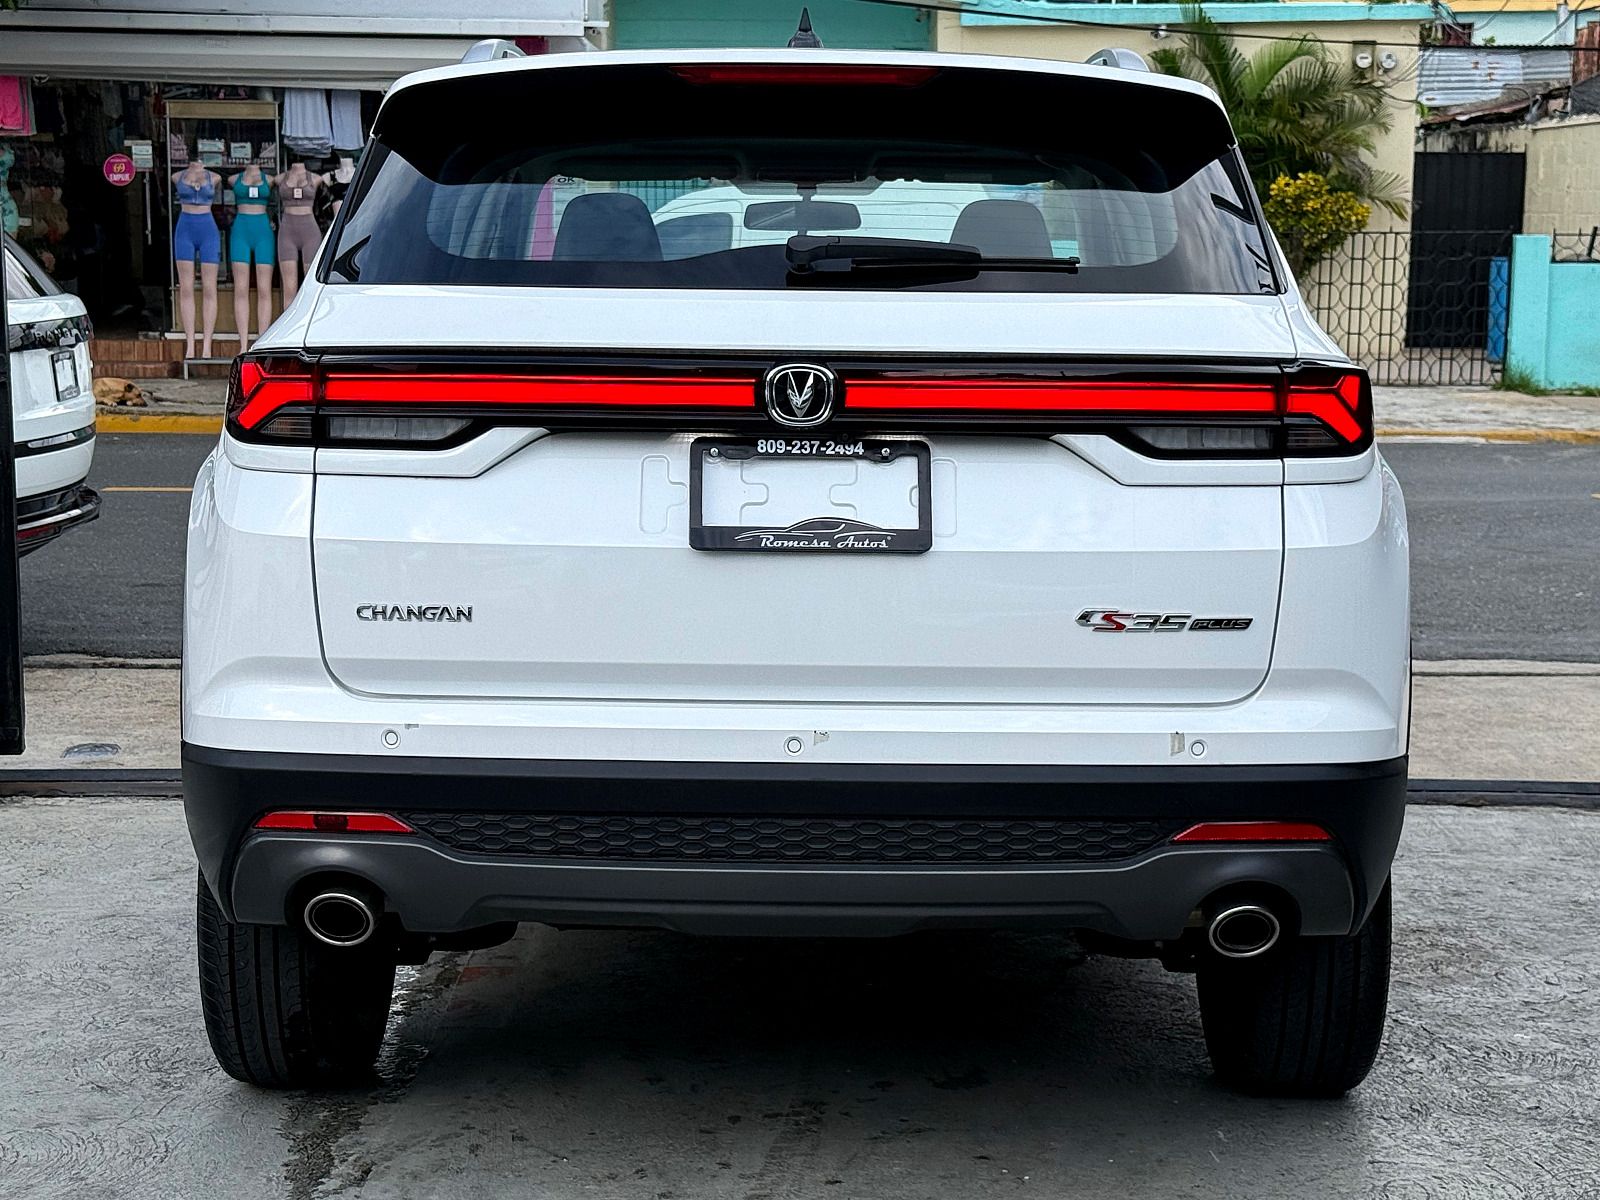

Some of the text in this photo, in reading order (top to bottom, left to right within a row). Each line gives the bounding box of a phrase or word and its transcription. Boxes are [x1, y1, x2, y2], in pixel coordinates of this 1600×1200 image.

[757, 440, 864, 455] 809-237-2494
[759, 535, 831, 548] Romesa
[356, 604, 473, 622] CHANGAN
[1074, 607, 1253, 633] CS35 PLUS
